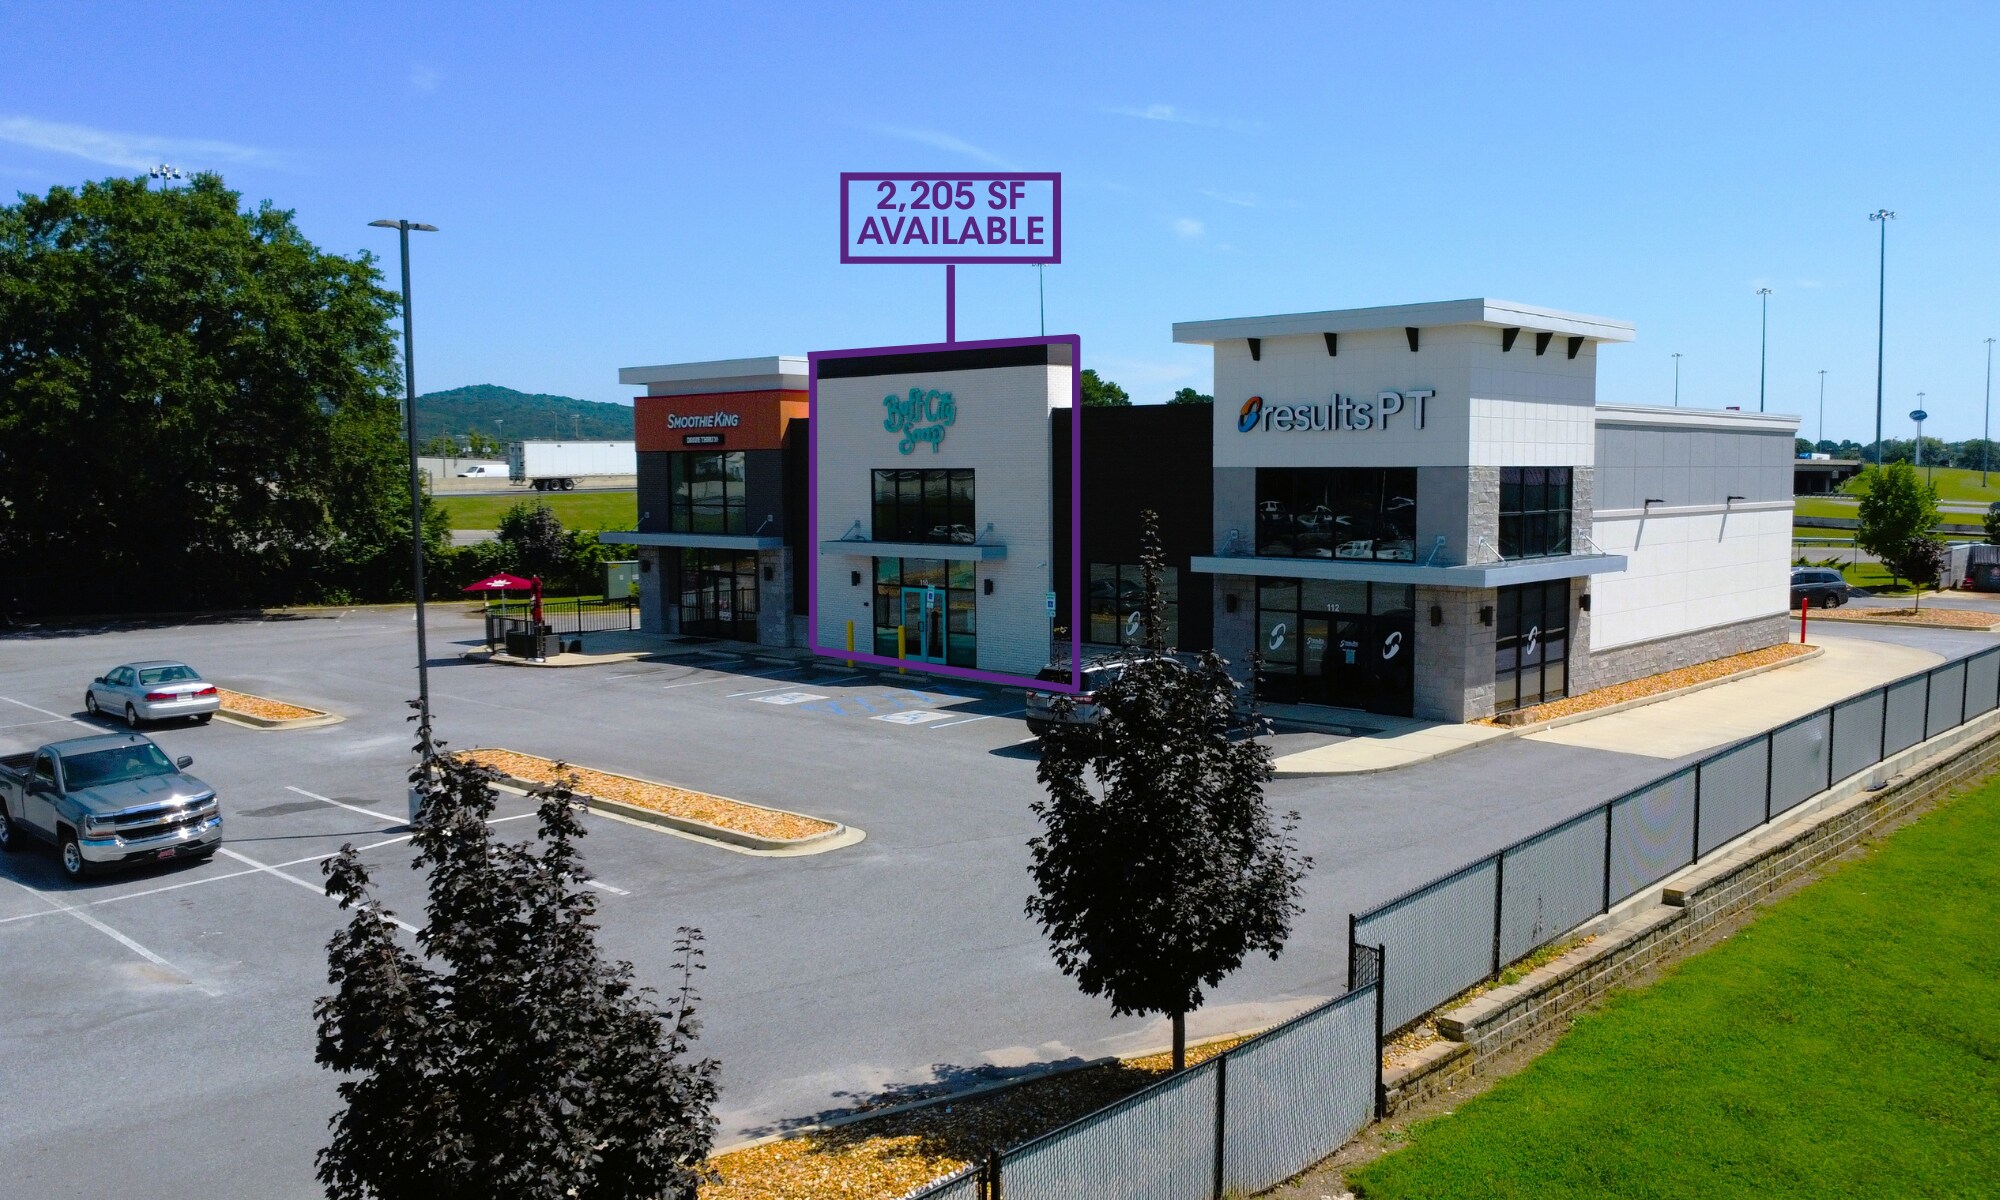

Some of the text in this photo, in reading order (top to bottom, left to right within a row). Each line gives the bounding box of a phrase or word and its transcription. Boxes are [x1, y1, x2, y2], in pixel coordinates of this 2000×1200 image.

[883, 387, 956, 433] Buff City
[1261, 389, 1435, 432] results PT
[898, 422, 945, 455] Soap
[1327, 604, 1340, 612] 112
